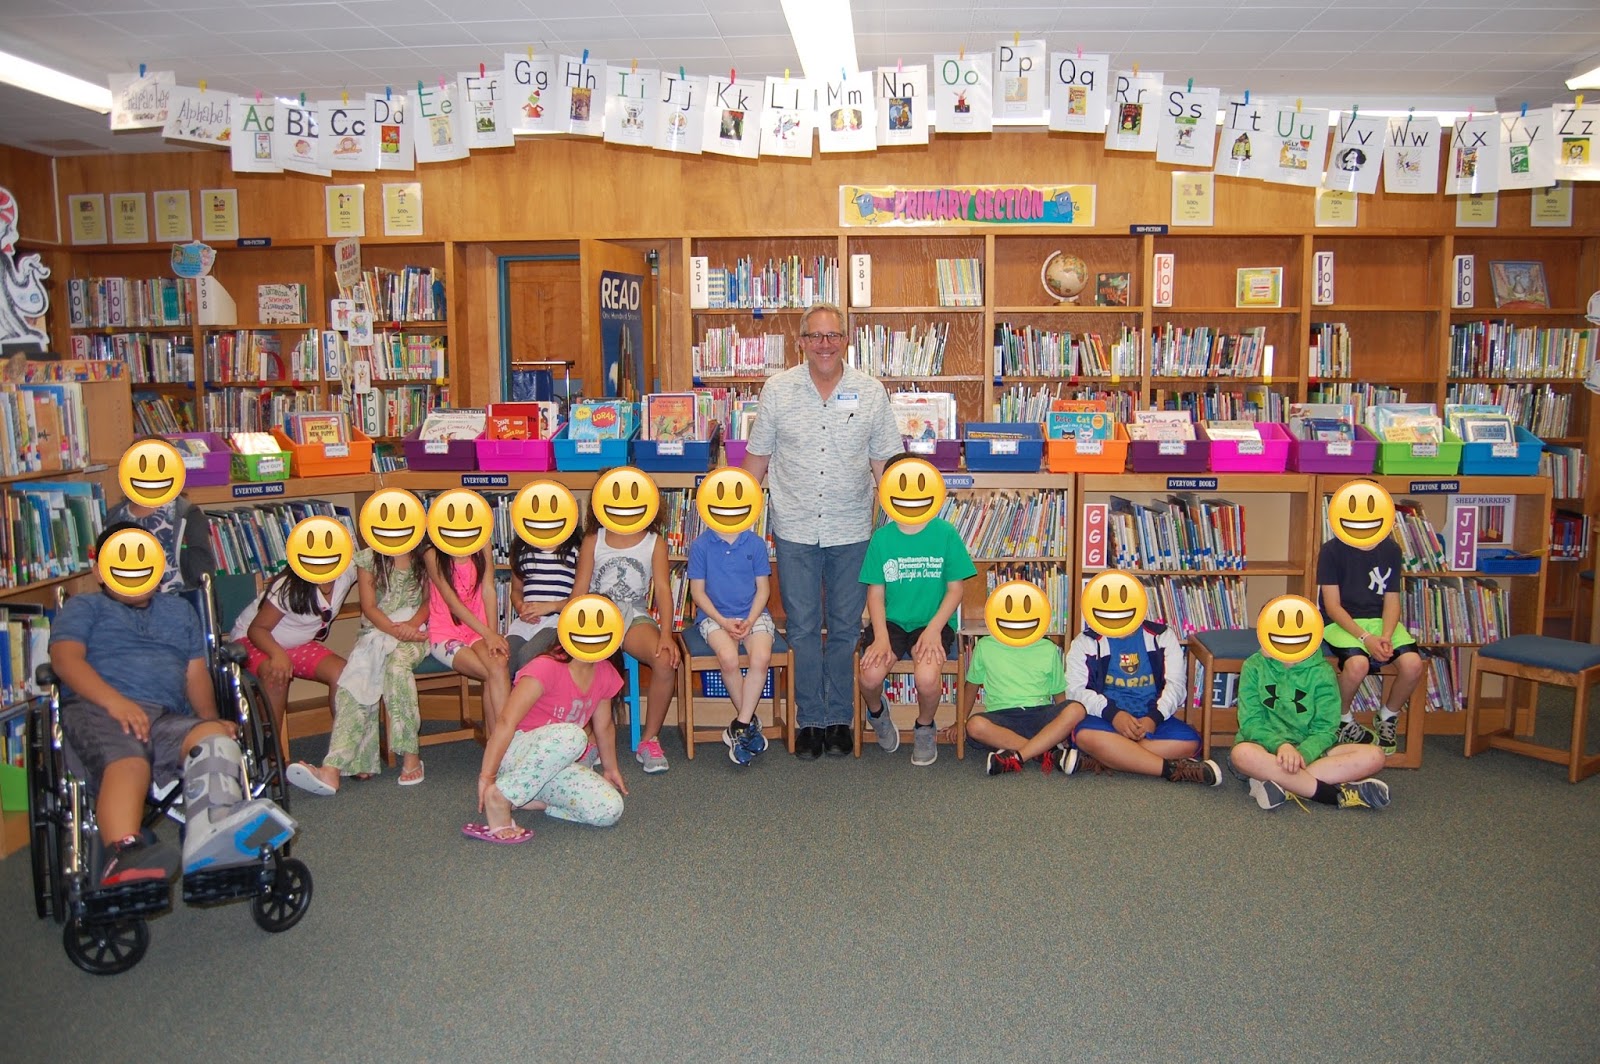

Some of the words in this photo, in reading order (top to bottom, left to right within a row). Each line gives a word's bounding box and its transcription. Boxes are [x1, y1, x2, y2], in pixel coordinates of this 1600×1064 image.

[515, 60, 548, 90] Gg
[565, 63, 596, 88] Hh
[883, 73, 914, 98] Nn
[1059, 59, 1094, 91] Qq
[466, 77, 500, 101] Ff
[662, 78, 692, 111] Jj
[716, 82, 749, 110] Kk
[827, 81, 862, 106] Mm
[1116, 77, 1147, 103] Rr
[178, 99, 231, 126] Alphabet
[374, 99, 404, 124] Dd
[418, 91, 453, 117] Ee
[1168, 91, 1202, 119] Ss
[1231, 102, 1261, 132] Tt
[1277, 111, 1313, 140] Uu
[1503, 116, 1540, 147] Yy
[1558, 109, 1593, 135] Zz
[894, 188, 971, 221] PRIMARY
[974, 187, 1044, 220] SECTION
[601, 277, 640, 311] READ
[592, 412, 616, 422] LORAX
[1076, 415, 1090, 423] Cat
[235, 486, 263, 495] EVERYONE
[265, 485, 283, 493] BOOKS
[1411, 483, 1439, 491] EVERYONE
